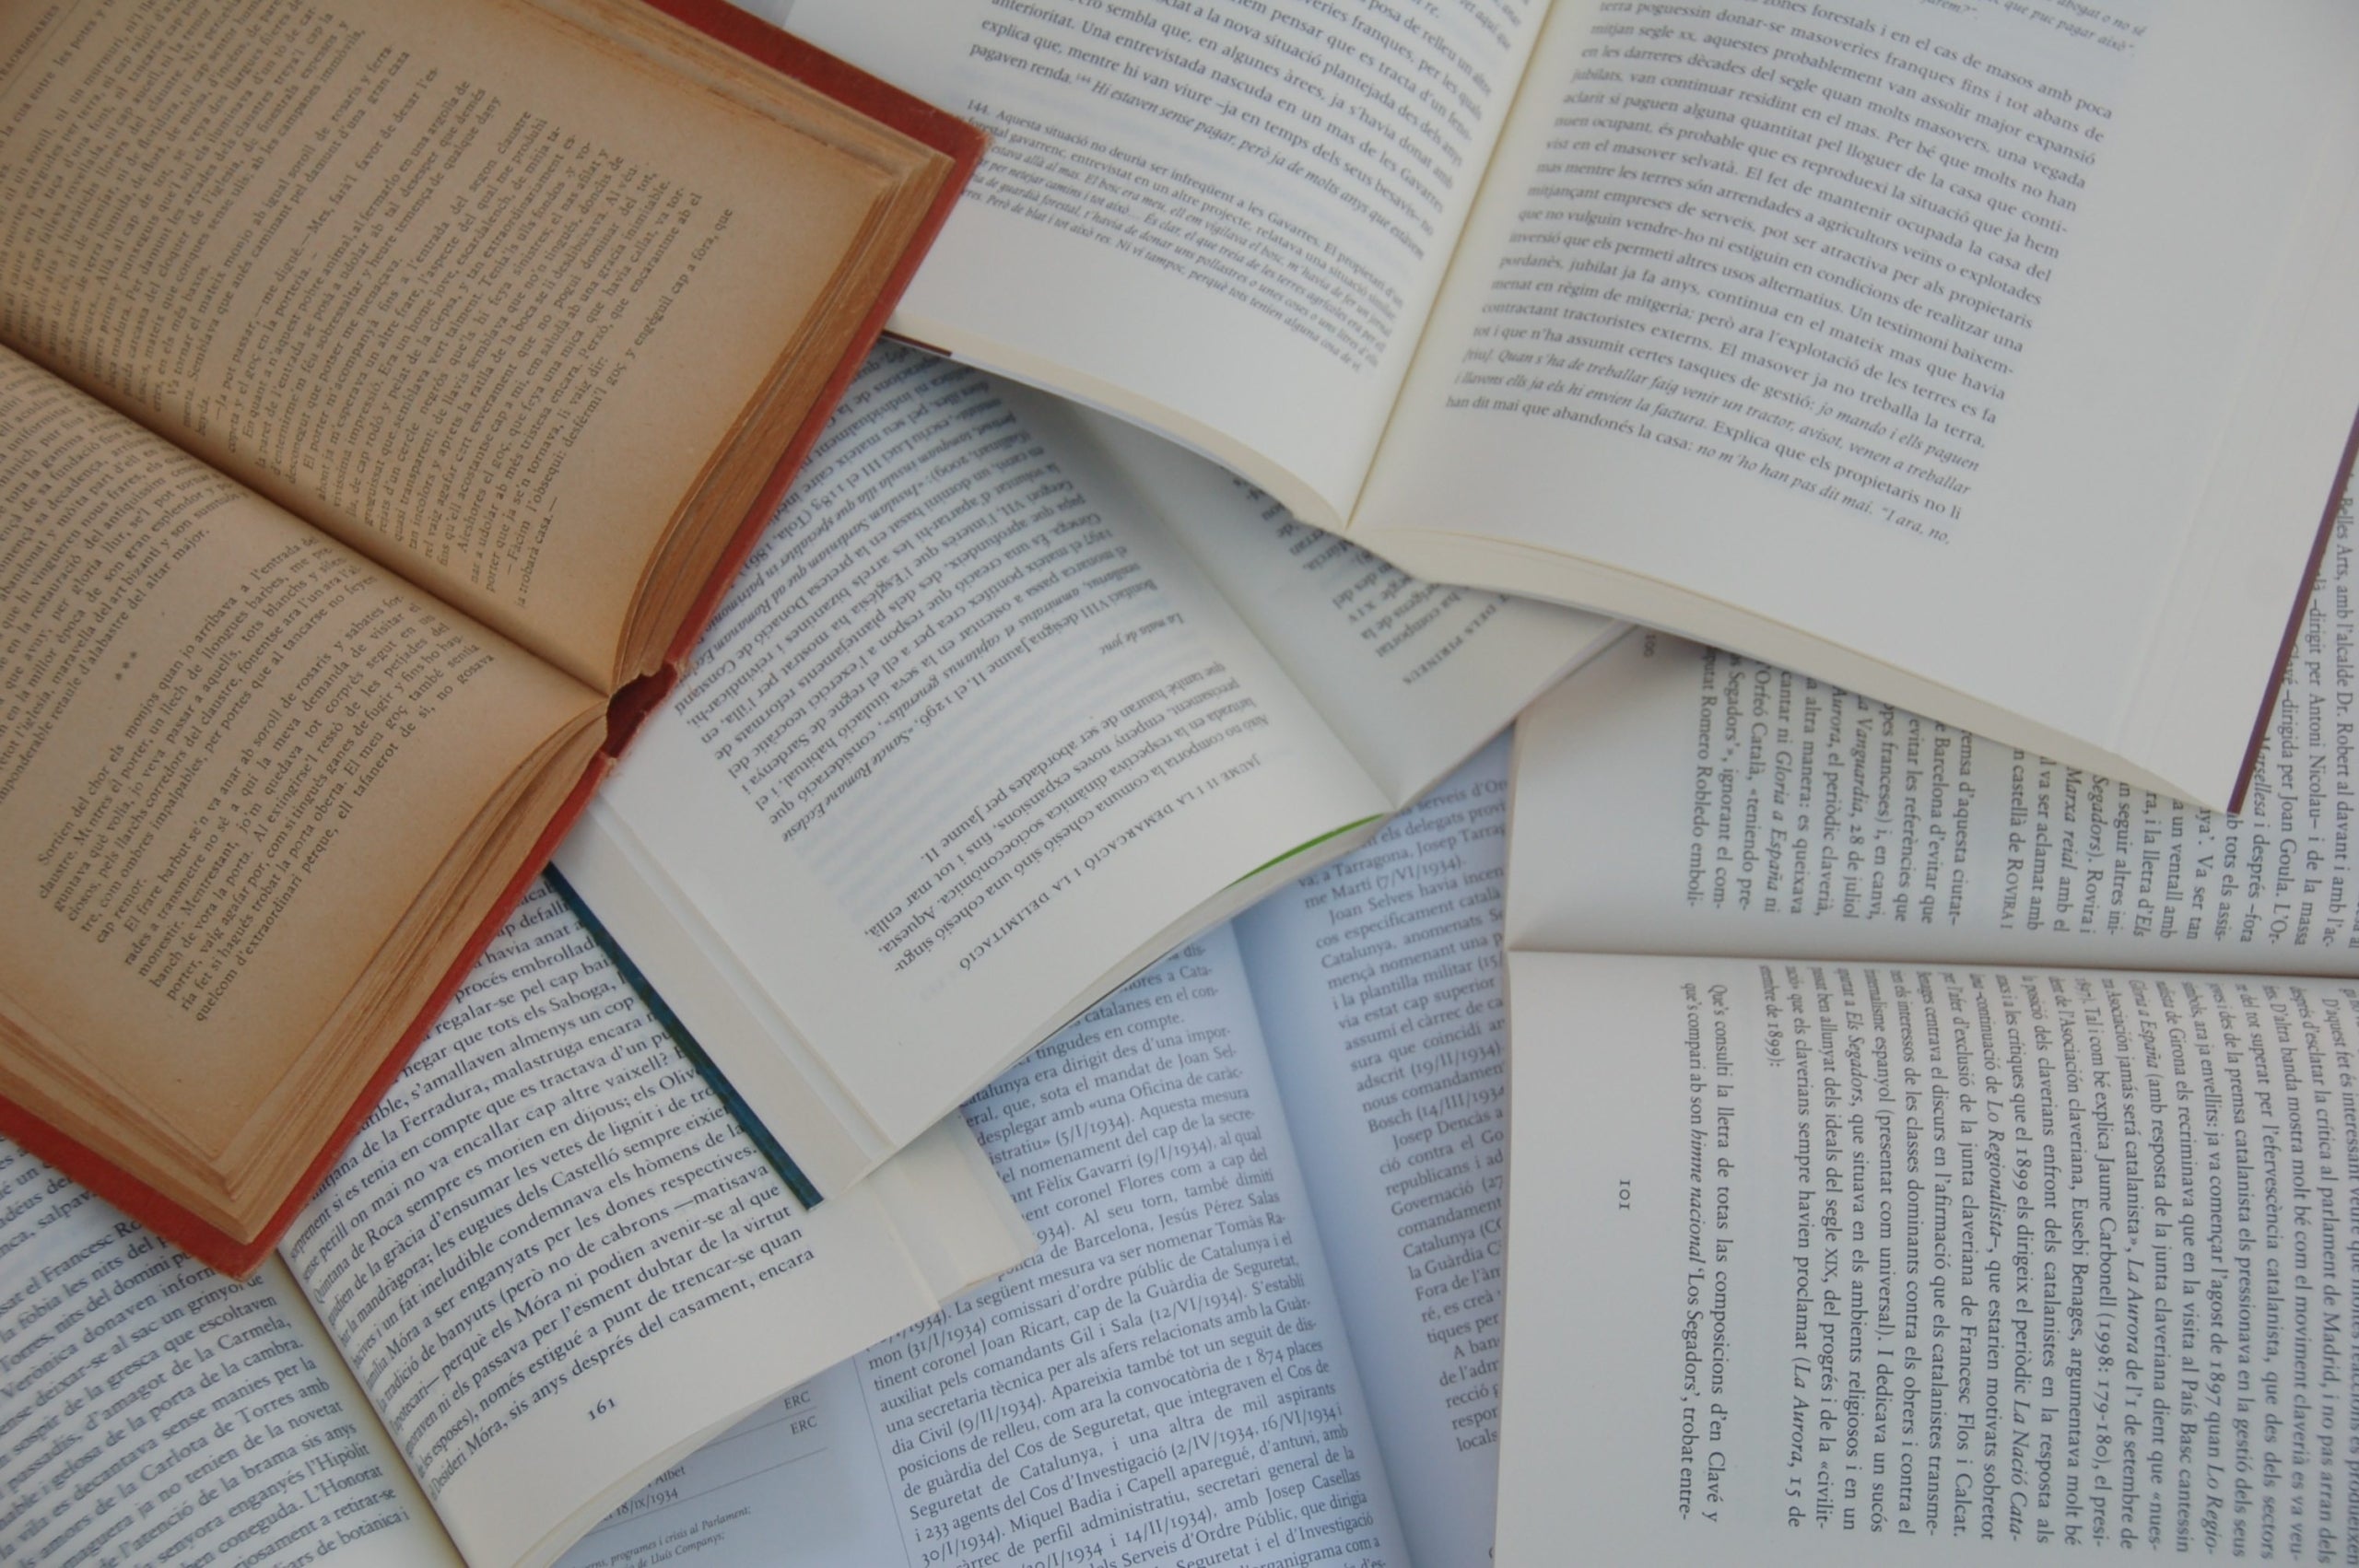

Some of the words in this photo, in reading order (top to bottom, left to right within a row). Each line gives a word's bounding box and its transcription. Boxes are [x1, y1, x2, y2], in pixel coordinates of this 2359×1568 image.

[995, 110, 1042, 133] Aquesta
[1044, 124, 1089, 147] situació
[1089, 141, 1108, 153] no
[1108, 146, 1147, 169] deuria
[1150, 163, 1169, 176] ser
[1247, 200, 1264, 217] les
[1267, 212, 1320, 248] Gavarres.
[1323, 241, 1338, 257] El
[1336, 252, 1386, 291] propietari
[624, 347, 636, 360] y
[671, 274, 689, 295] cap
[687, 263, 697, 273] a
[714, 208, 734, 231] que
[1445, 394, 1470, 408] han
[1472, 395, 1491, 410] dit
[1492, 399, 1520, 412] mai
[1521, 404, 1551, 417] que
[1552, 405, 1634, 435] abandonés
[1637, 423, 1652, 439] la
[1655, 433, 1694, 451] casa:
[1696, 445, 1717, 458] no
[1718, 451, 1758, 471] m'ho
[1758, 462, 1790, 483] han
[1789, 476, 1817, 493] pas
[1818, 485, 1840, 501] dit
[1841, 495, 1873, 515] mai.
[1440, 591, 1461, 609] ha
[1375, 607, 1441, 659] comportat
[1463, 603, 1497, 635] DELS
[1402, 635, 1464, 685] PIRINEUS
[2304, 661, 2321, 686] per
[1166, 672, 1205, 696] també
[1119, 688, 1168, 718] hauran
[1803, 696, 1823, 734] altra
[1079, 727, 1100, 744] ser
[1100, 714, 1119, 730] de
[1776, 728, 1793, 743] ni
[2308, 693, 2327, 747] Antoni
[1008, 740, 1078, 793] abordades
[1220, 753, 1262, 782] JAUME
[1773, 750, 1793, 805] Gloria
[1799, 740, 1814, 808] manera:
[1175, 790, 1195, 805] LA
[1196, 785, 1205, 795] I
[1205, 778, 1220, 790] II
[985, 788, 1008, 813] per
[1772, 810, 1784, 822] a
[195, 968, 239, 1022] quelcom
[235, 872, 303, 966] d'extraordinari
[337, 800, 354, 820] ell
[353, 743, 399, 797] tafanerot
[399, 722, 417, 738] de
[417, 705, 436, 719] si,
[436, 685, 453, 701] no
[456, 654, 495, 685] gosava
[940, 805, 985, 848] Jaume
[1084, 803, 1175, 871] DEMARCACIÓ
[1797, 813, 1810, 832] es
[921, 847, 940, 863] II.
[1765, 827, 1788, 892] España
[2306, 849, 2325, 871] de
[1051, 875, 1072, 891] LA
[1073, 867, 1082, 877] I
[1790, 837, 1811, 915] queixava
[2303, 878, 2323, 894] la
[1304, 894, 1328, 910] me
[1331, 877, 1373, 901] Martí
[1764, 897, 1780, 913] ni
[959, 892, 1050, 971] DELIMITACIÓ
[2294, 901, 2314, 946] massa
[1680, 982, 1703, 1011] que's
[1707, 984, 1730, 1016] Que's
[1684, 1012, 1707, 1070] compari
[1714, 1021, 1734, 1076] consulti
[1356, 1067, 1405, 1093] adscrit
[1689, 1073, 1708, 1093] ab
[1717, 1084, 1734, 1098] la
[1690, 1096, 1702, 1125] son
[1717, 1106, 1735, 1148] lletra
[1690, 1129, 1708, 1183] himne
[1717, 1157, 1735, 1178] de
[1618, 1179, 1631, 1211] 101
[1716, 1186, 1730, 1230] totas
[1688, 1187, 1707, 1264] nacional
[1716, 1238, 1734, 1262] las
[874, 1365, 918, 1391] tinent
[921, 1341, 977, 1374] coronel
[980, 1333, 1015, 1357] Joan
[1019, 1314, 1070, 1340] Ricart,
[1074, 1305, 1100, 1321] cap
[1105, 1295, 1123, 1312] de
[1126, 1290, 1143, 1305] la
[1145, 1272, 1208, 1299] Guàrdia
[1212, 1267, 1229, 1282] de
[1709, 1270, 1731, 1395] composicions
[430, 1447, 467, 1494] Desideri
[464, 1421, 509, 1456] Móra,
[509, 1399, 529, 1421] sis
[532, 1374, 569, 1404] anys
[571, 1334, 634, 1376] després
[638, 1314, 664, 1339] del
[668, 1279, 756, 1323] casament,
[758, 1249, 815, 1281] encara
[588, 1398, 616, 1421] 161
[782, 1390, 811, 1410] ERC
[790, 1414, 817, 1435] ERC
[1681, 1407, 1700, 1464] trobat
[1709, 1403, 1729, 1442] d'en
[94, 1496, 117, 1516] de
[116, 1481, 139, 1499] la
[139, 1436, 209, 1482] Carlota
[213, 1421, 235, 1439] de
[239, 1393, 296, 1422] Torres
[298, 1376, 330, 1399] amb
[1706, 1451, 1726, 1503] Clavé
[1678, 1467, 1693, 1520] entre-
[1701, 1511, 1718, 1523] y
[610, 1540, 657, 1567] programes
[658, 1535, 663, 1547] i
[664, 1527, 688, 1544] crisis
[689, 1522, 699, 1536] al
[651, 1550, 674, 1565] Lluís
